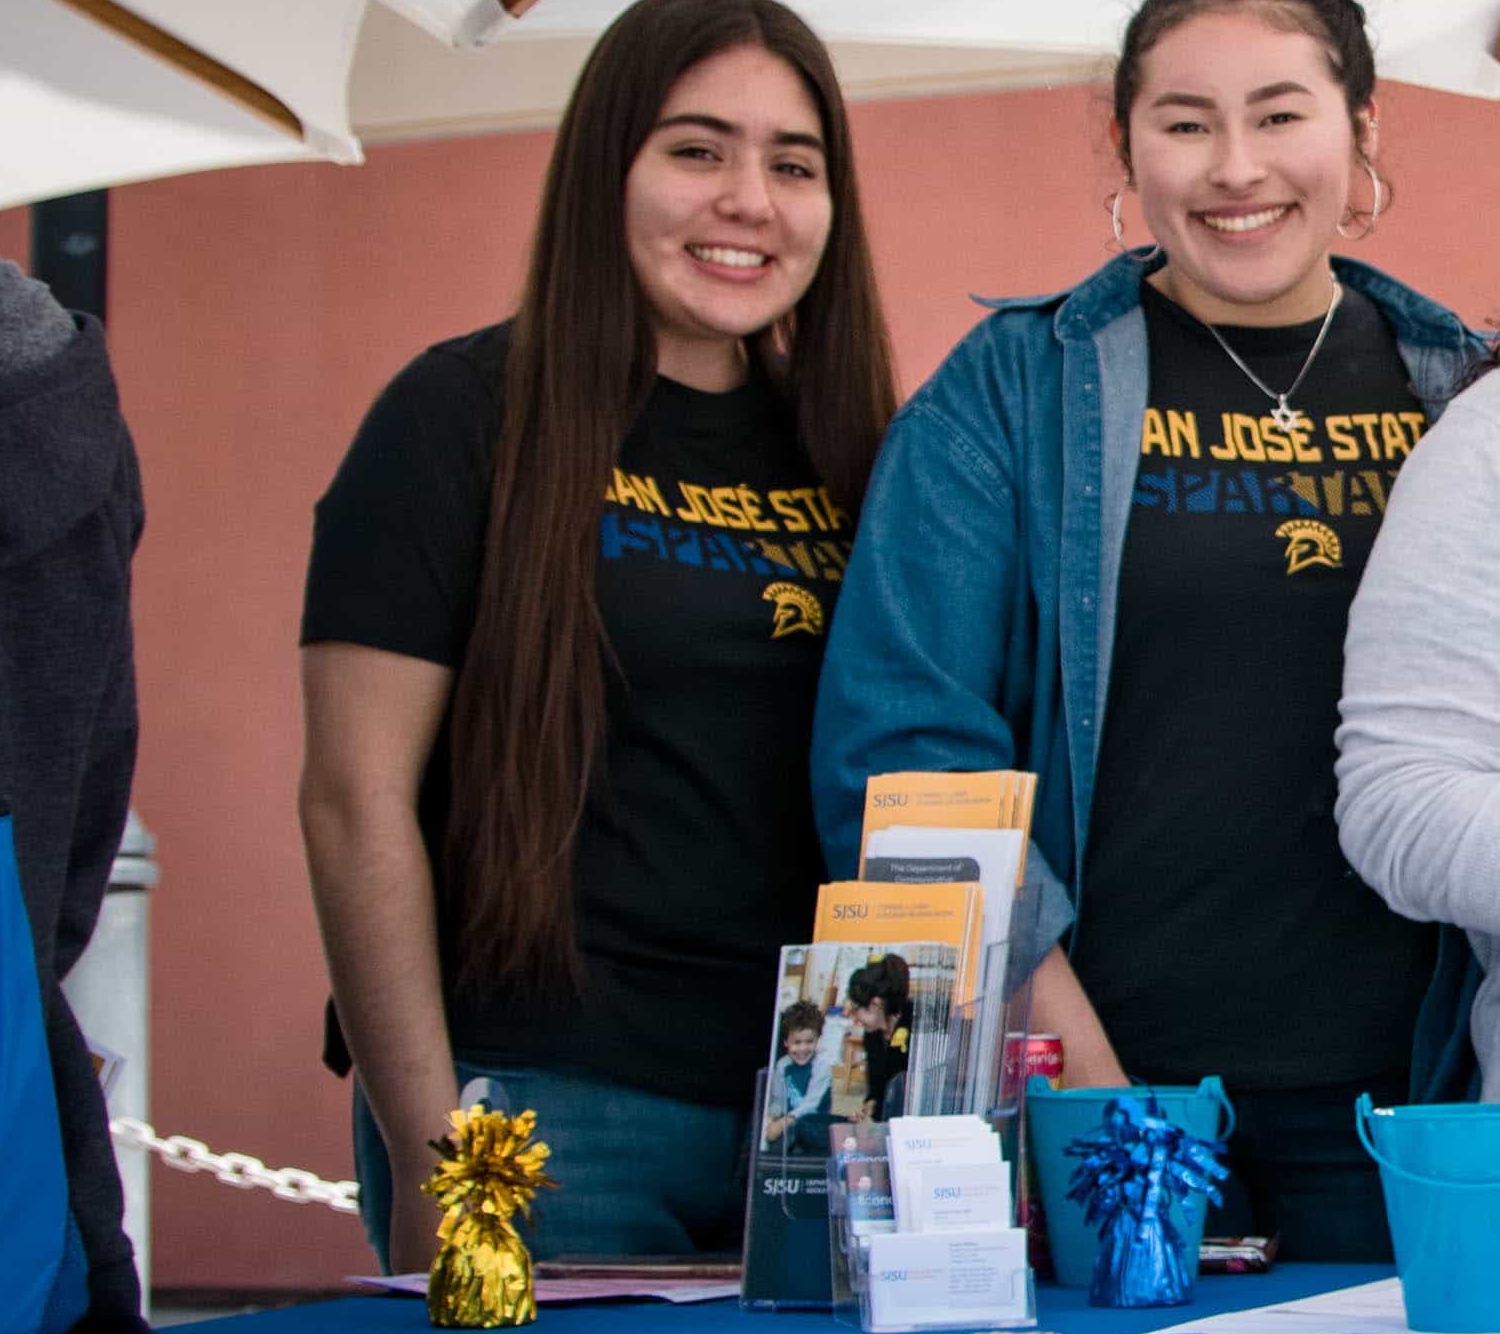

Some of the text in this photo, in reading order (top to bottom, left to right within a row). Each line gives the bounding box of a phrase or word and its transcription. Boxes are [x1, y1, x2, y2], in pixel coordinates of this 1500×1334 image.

[1140, 406, 1202, 460] AN
[1324, 410, 1426, 463] STAT
[676, 480, 779, 532] JOSÉ
[873, 794, 909, 808] SJSU
[832, 903, 869, 920] SJSU
[763, 1177, 800, 1197] SJSU
